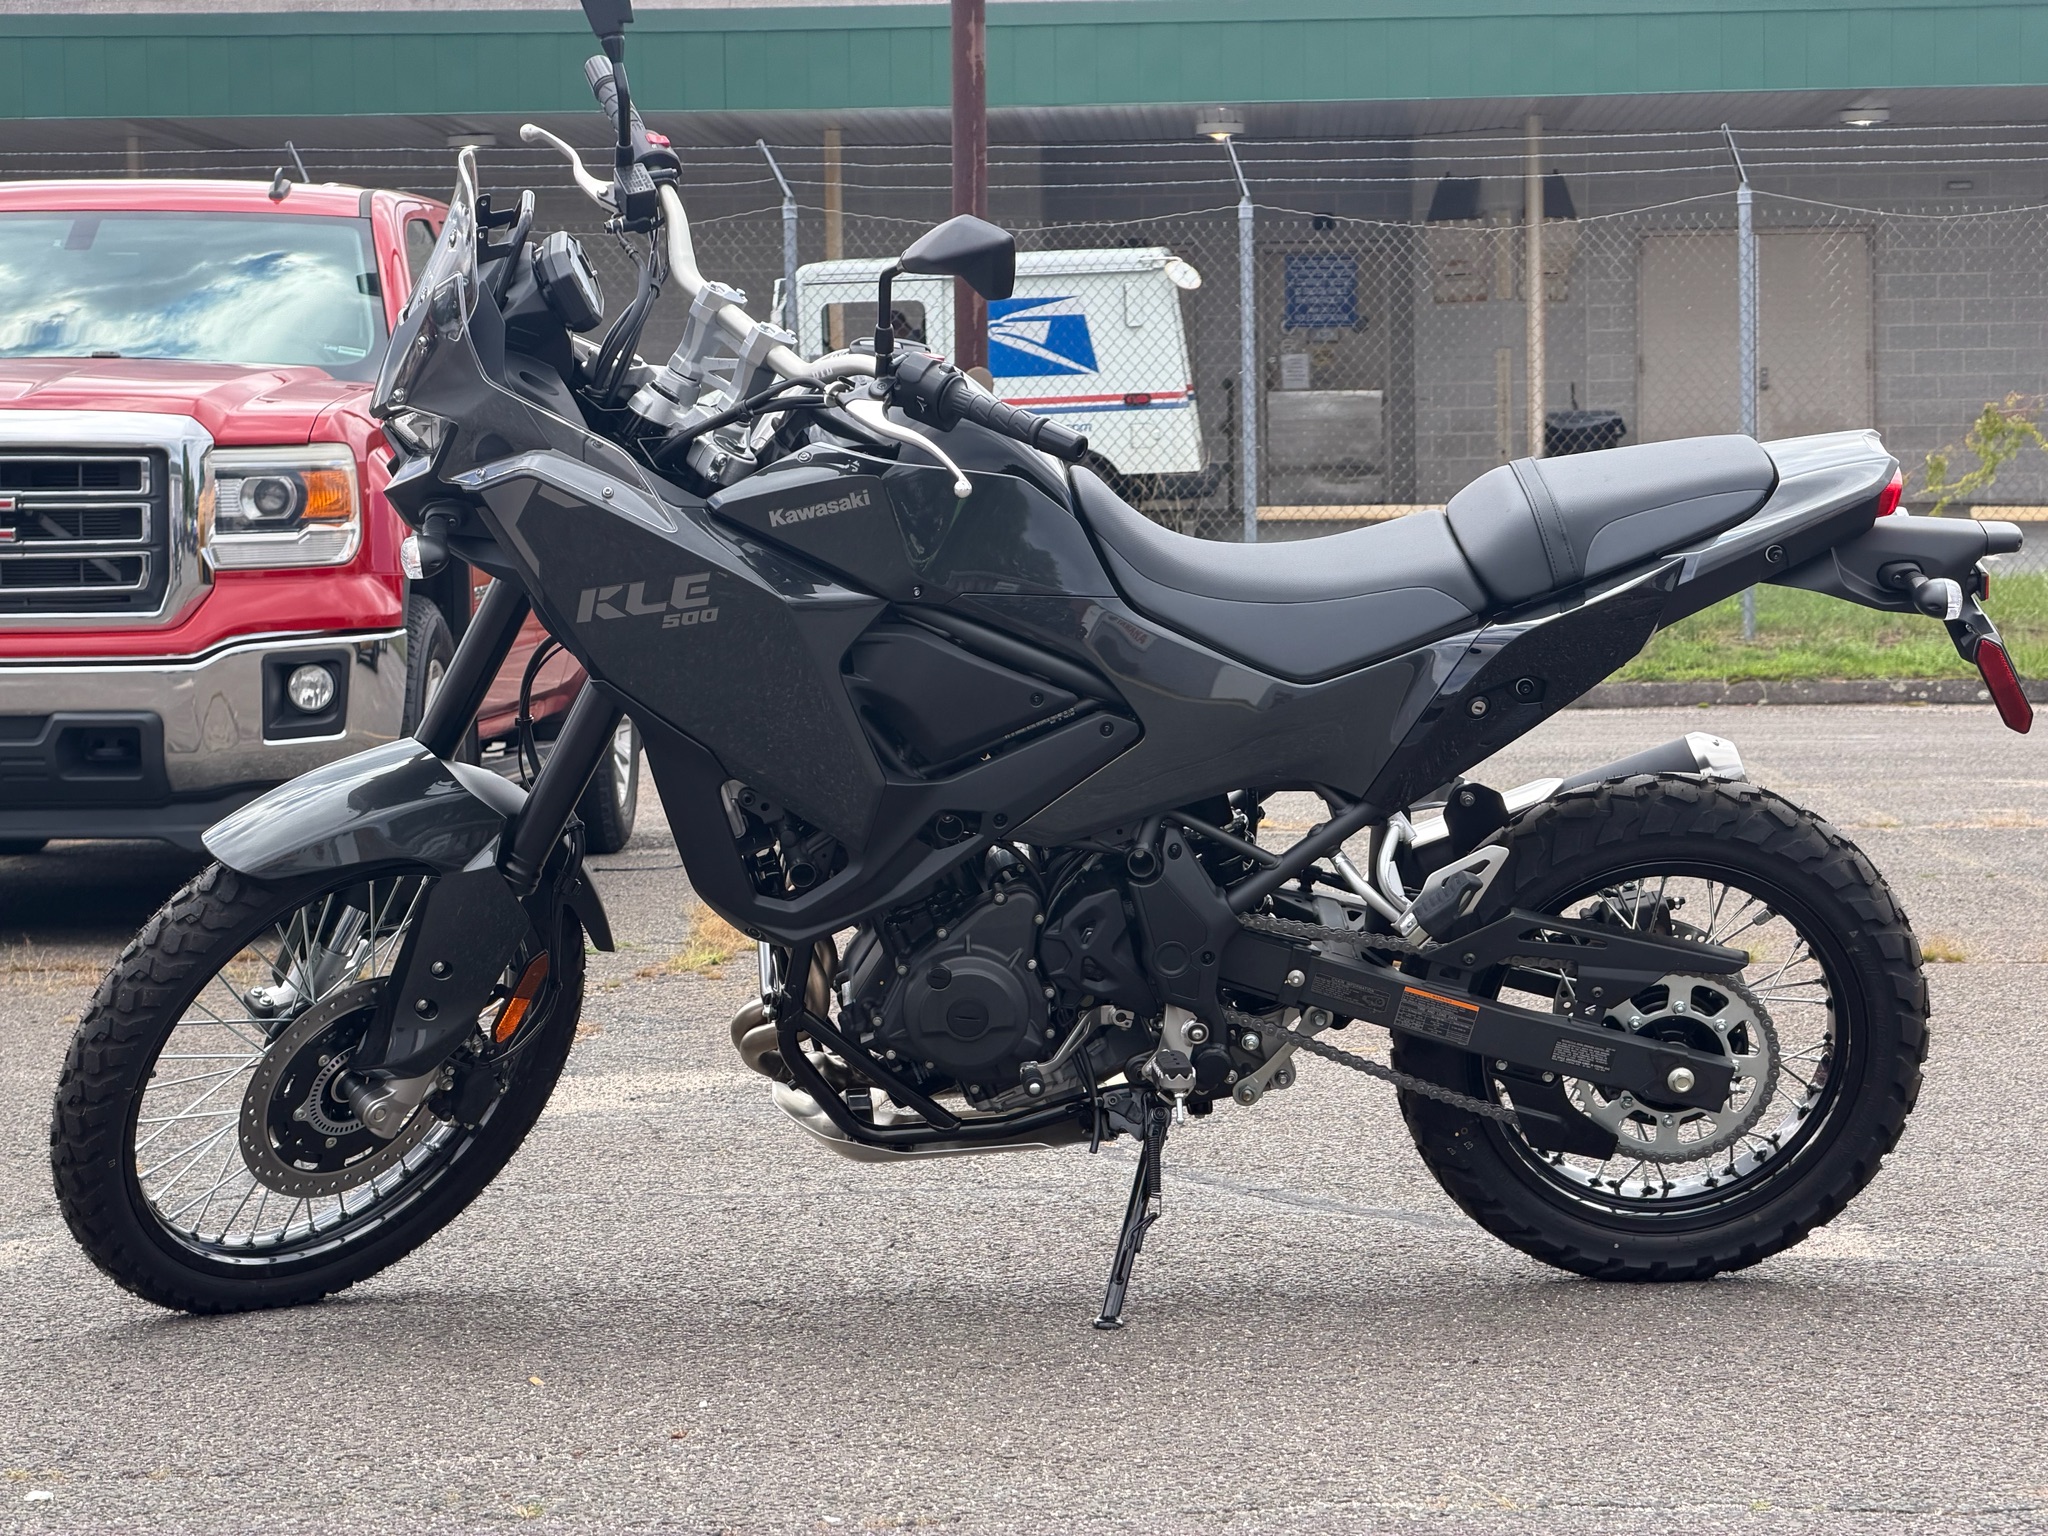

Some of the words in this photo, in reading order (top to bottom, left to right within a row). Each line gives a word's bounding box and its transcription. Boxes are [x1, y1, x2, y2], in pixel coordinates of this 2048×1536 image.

[768, 489, 871, 527] Kawasaki
[576, 572, 711, 623] KLE
[662, 607, 719, 629] 500
